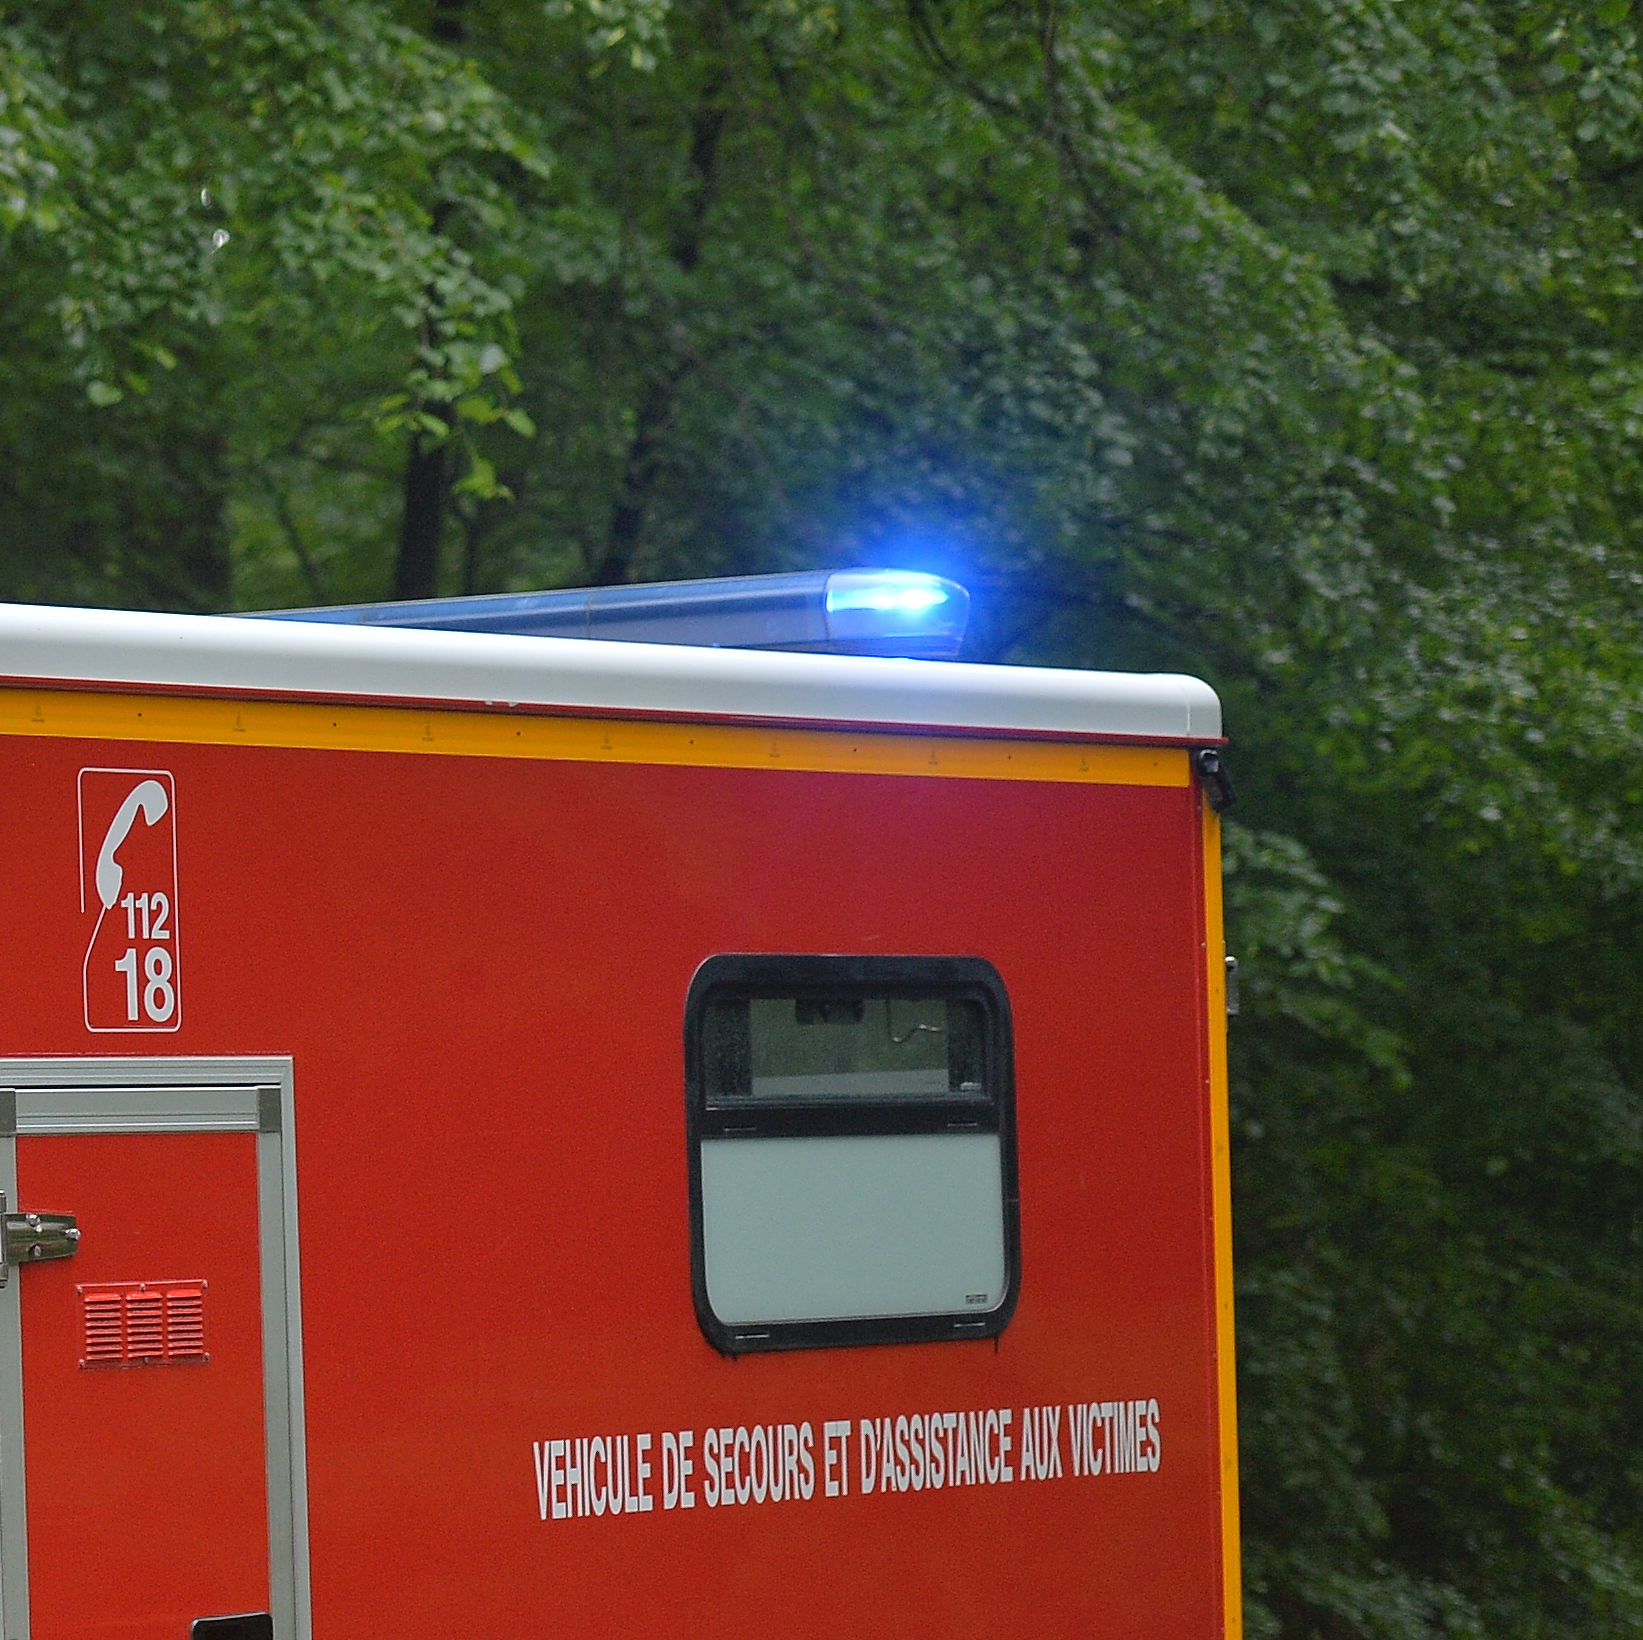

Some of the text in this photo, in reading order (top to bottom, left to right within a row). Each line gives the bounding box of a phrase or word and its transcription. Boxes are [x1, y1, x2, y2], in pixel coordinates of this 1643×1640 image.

[121, 892, 170, 939] 112
[115, 947, 175, 1022] 18
[532, 1397, 1161, 1521] VEHICULE DE SECOURS ET D'ASSISTANCE AUX VICTIMES
